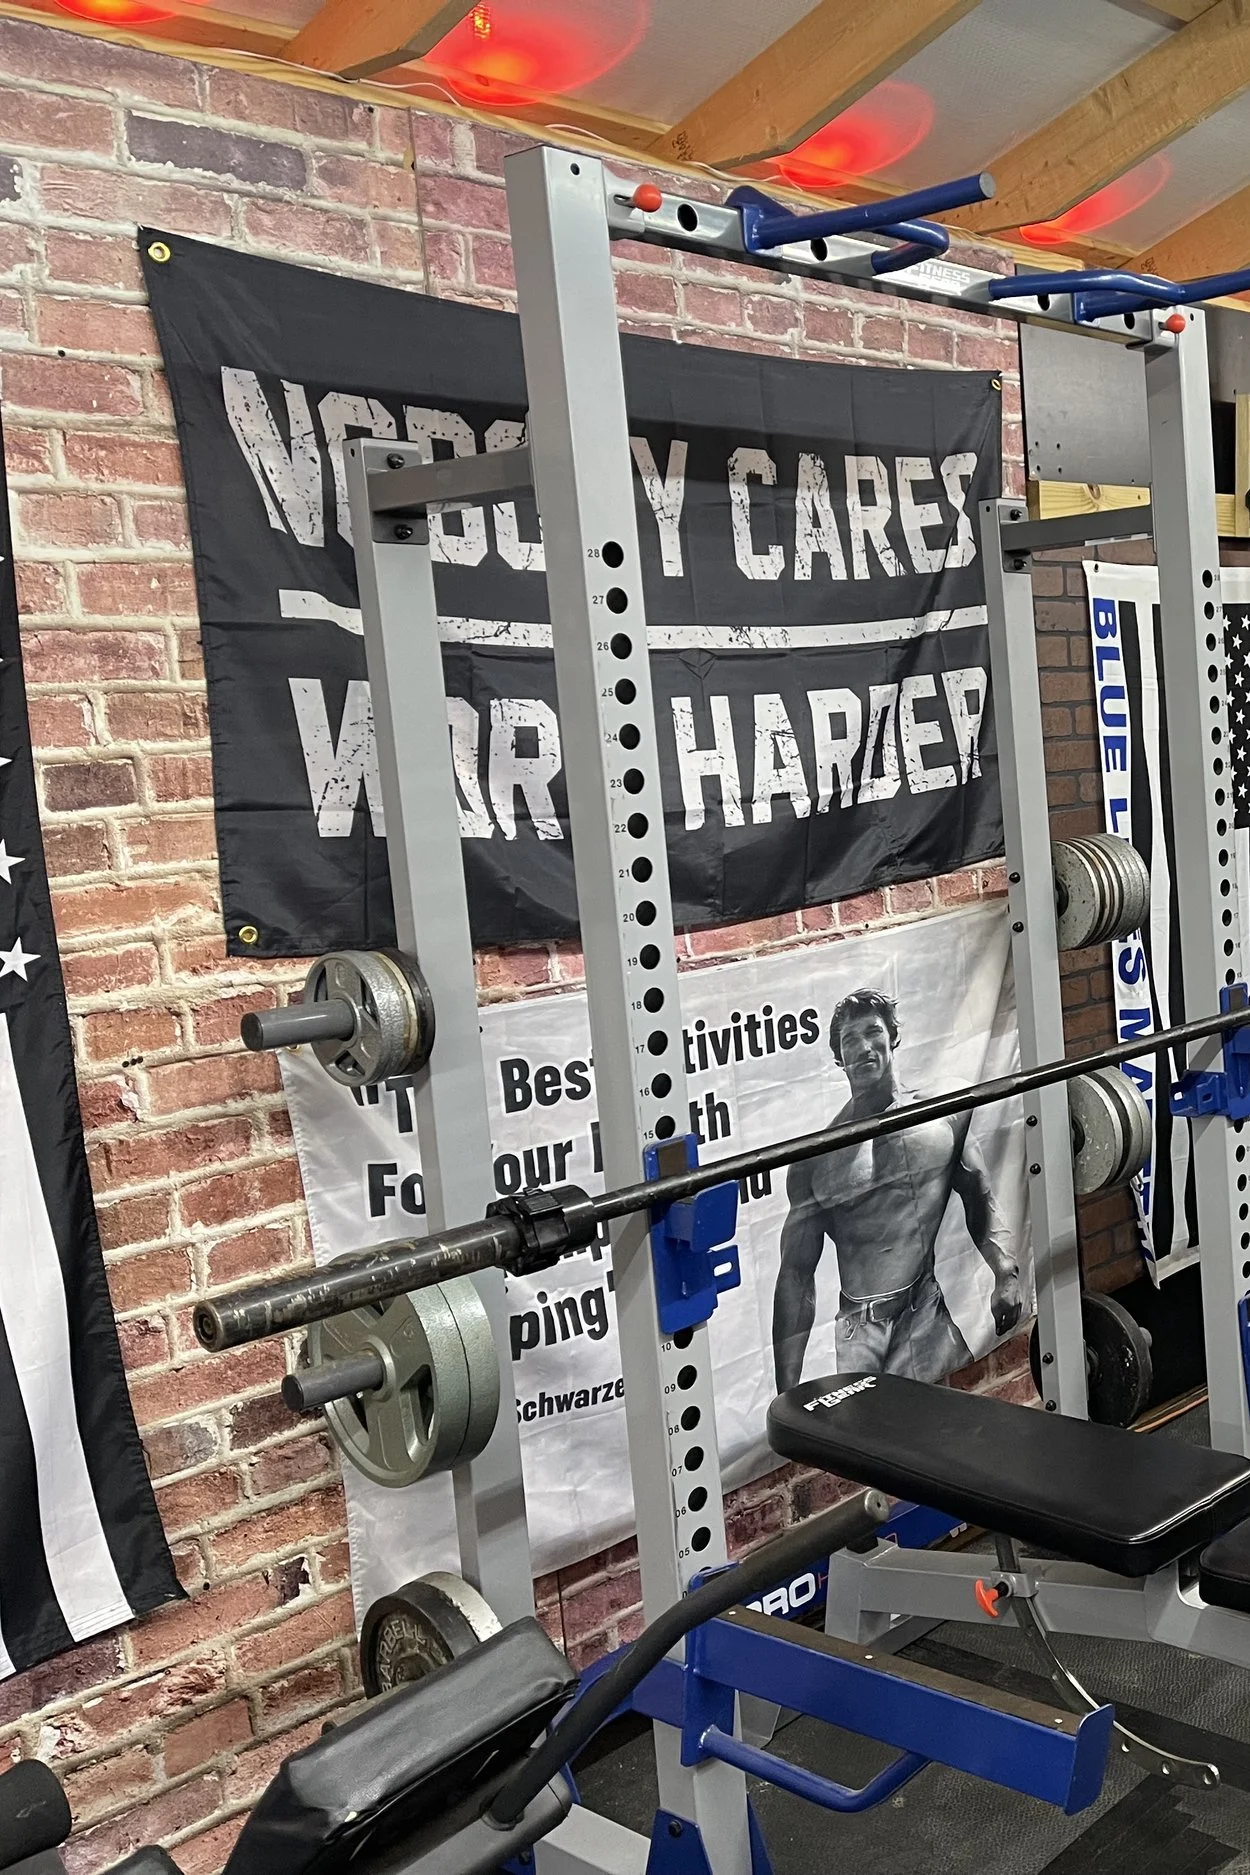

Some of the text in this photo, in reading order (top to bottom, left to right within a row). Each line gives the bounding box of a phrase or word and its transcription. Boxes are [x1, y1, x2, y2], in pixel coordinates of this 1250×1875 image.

[727, 447, 977, 580] CARES
[587, 549, 600, 558] 28
[592, 595, 604, 604] 27
[597, 641, 609, 651] 26
[1093, 597, 1127, 772] BLUE
[601, 687, 614, 697] 25
[606, 733, 618, 742] 24
[671, 666, 987, 831] HARDER
[610, 779, 622, 788] 23
[614, 824, 627, 833] 22
[619, 869, 630, 878] 21
[623, 913, 635, 922] 20
[627, 958, 638, 967] 19
[631, 1001, 642, 1010] 18
[635, 1044, 645, 1054] 17
[500, 1050, 594, 1114] Bes
[639, 1087, 650, 1097] 16
[644, 1130, 654, 1140] 15
[368, 1163, 427, 1218] Fo
[661, 1342, 671, 1352] 10
[664, 1384, 676, 1394] 09
[668, 1425, 680, 1436] 08
[672, 1466, 682, 1477] 07
[675, 1507, 687, 1518] 06
[679, 1547, 690, 1559] 05
[380, 1618, 426, 1694] BARBELL
